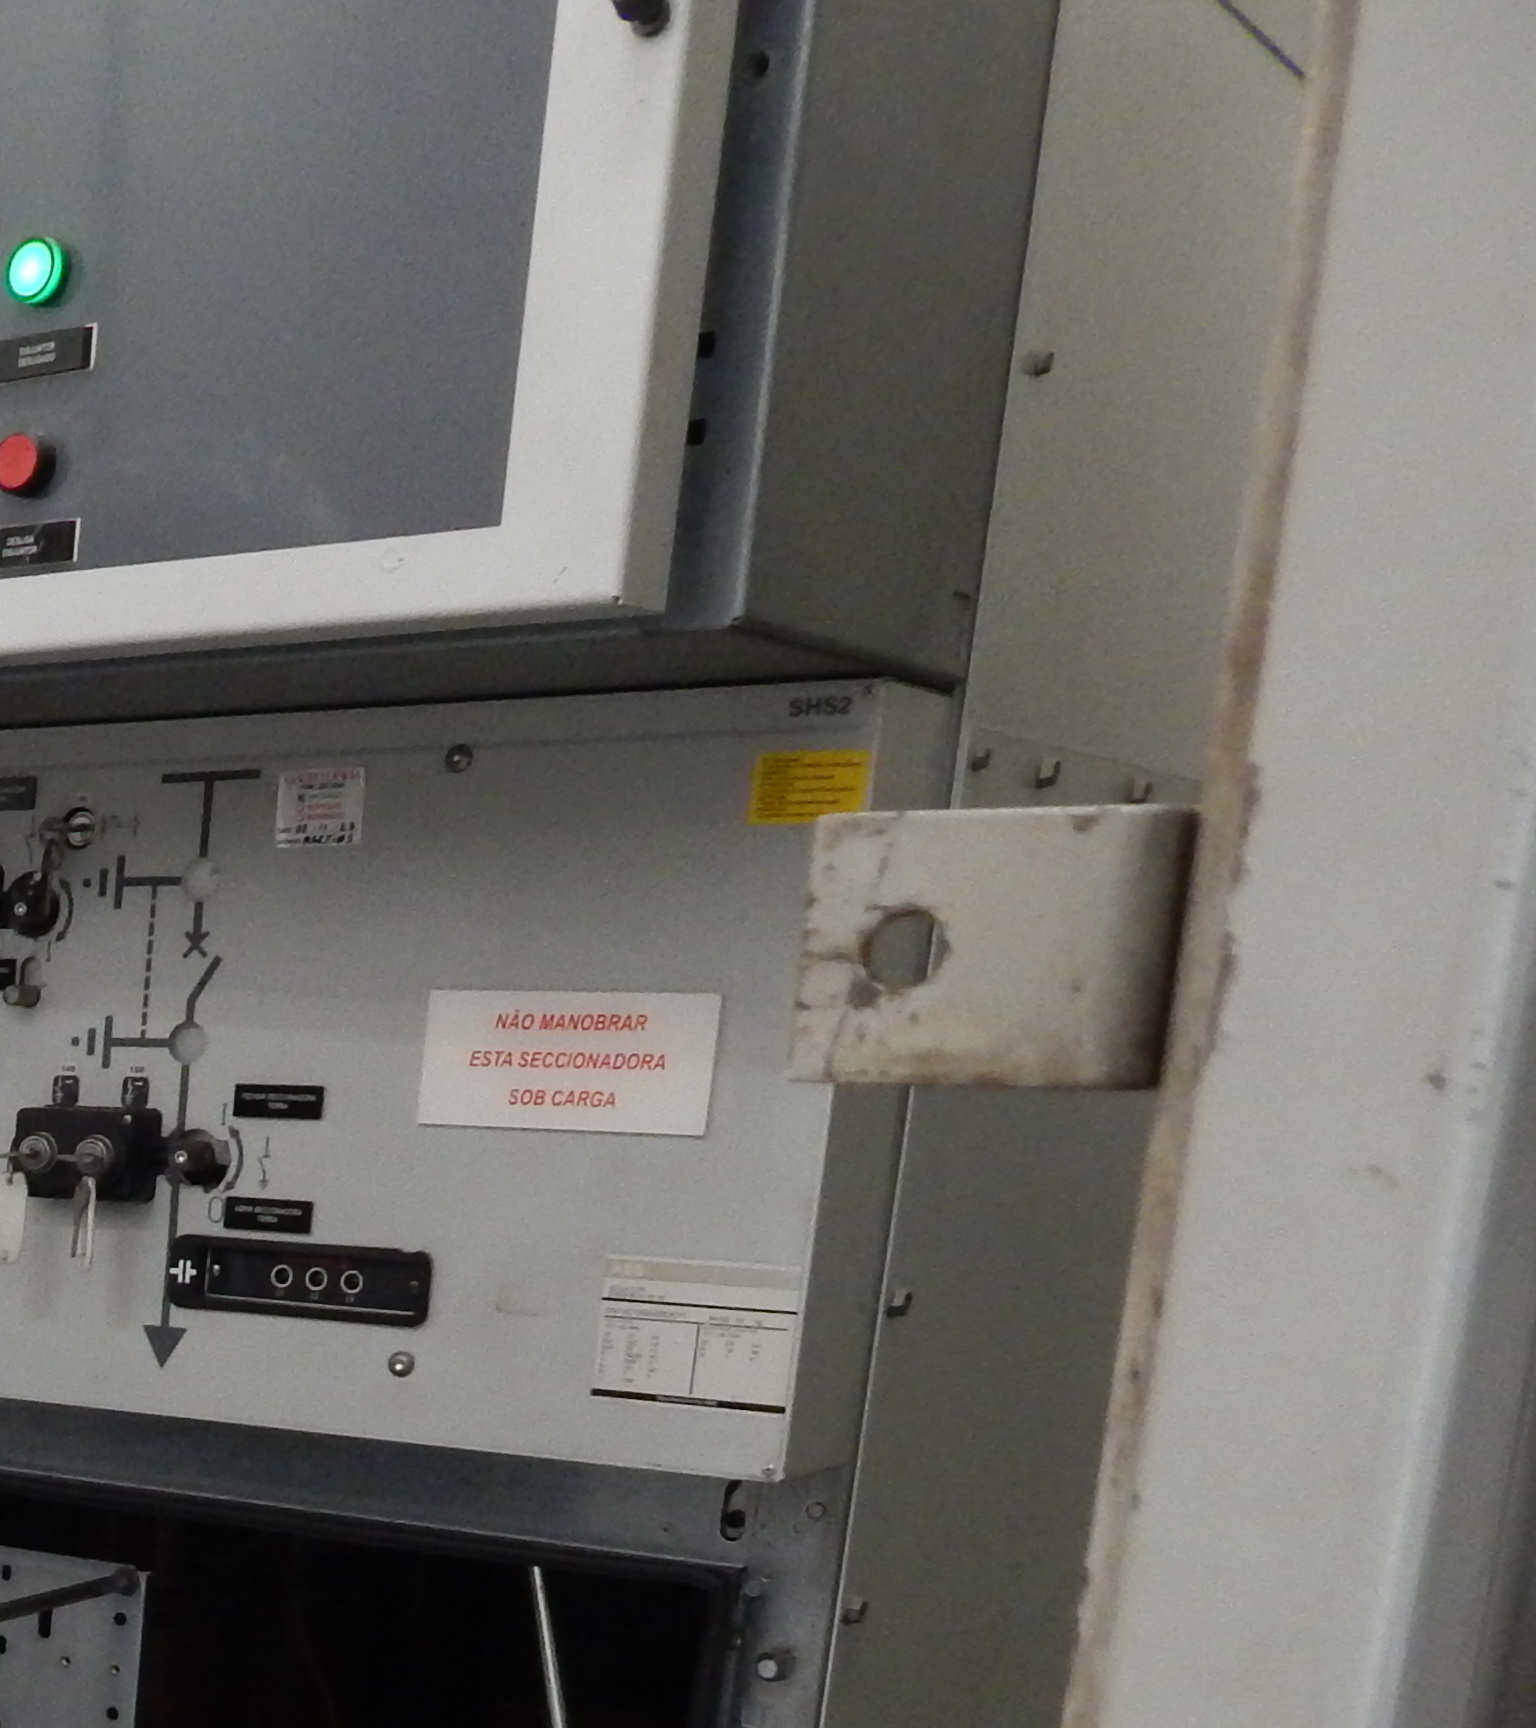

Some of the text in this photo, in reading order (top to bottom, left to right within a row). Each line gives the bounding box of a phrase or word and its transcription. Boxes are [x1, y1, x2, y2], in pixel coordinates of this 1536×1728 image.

[788, 695, 854, 718] SHS2
[494, 1009, 648, 1032] NÃO MANOBRAR
[468, 1050, 667, 1071] ESTA SECCIONADORA
[507, 1088, 617, 1108] SOB CARGA
